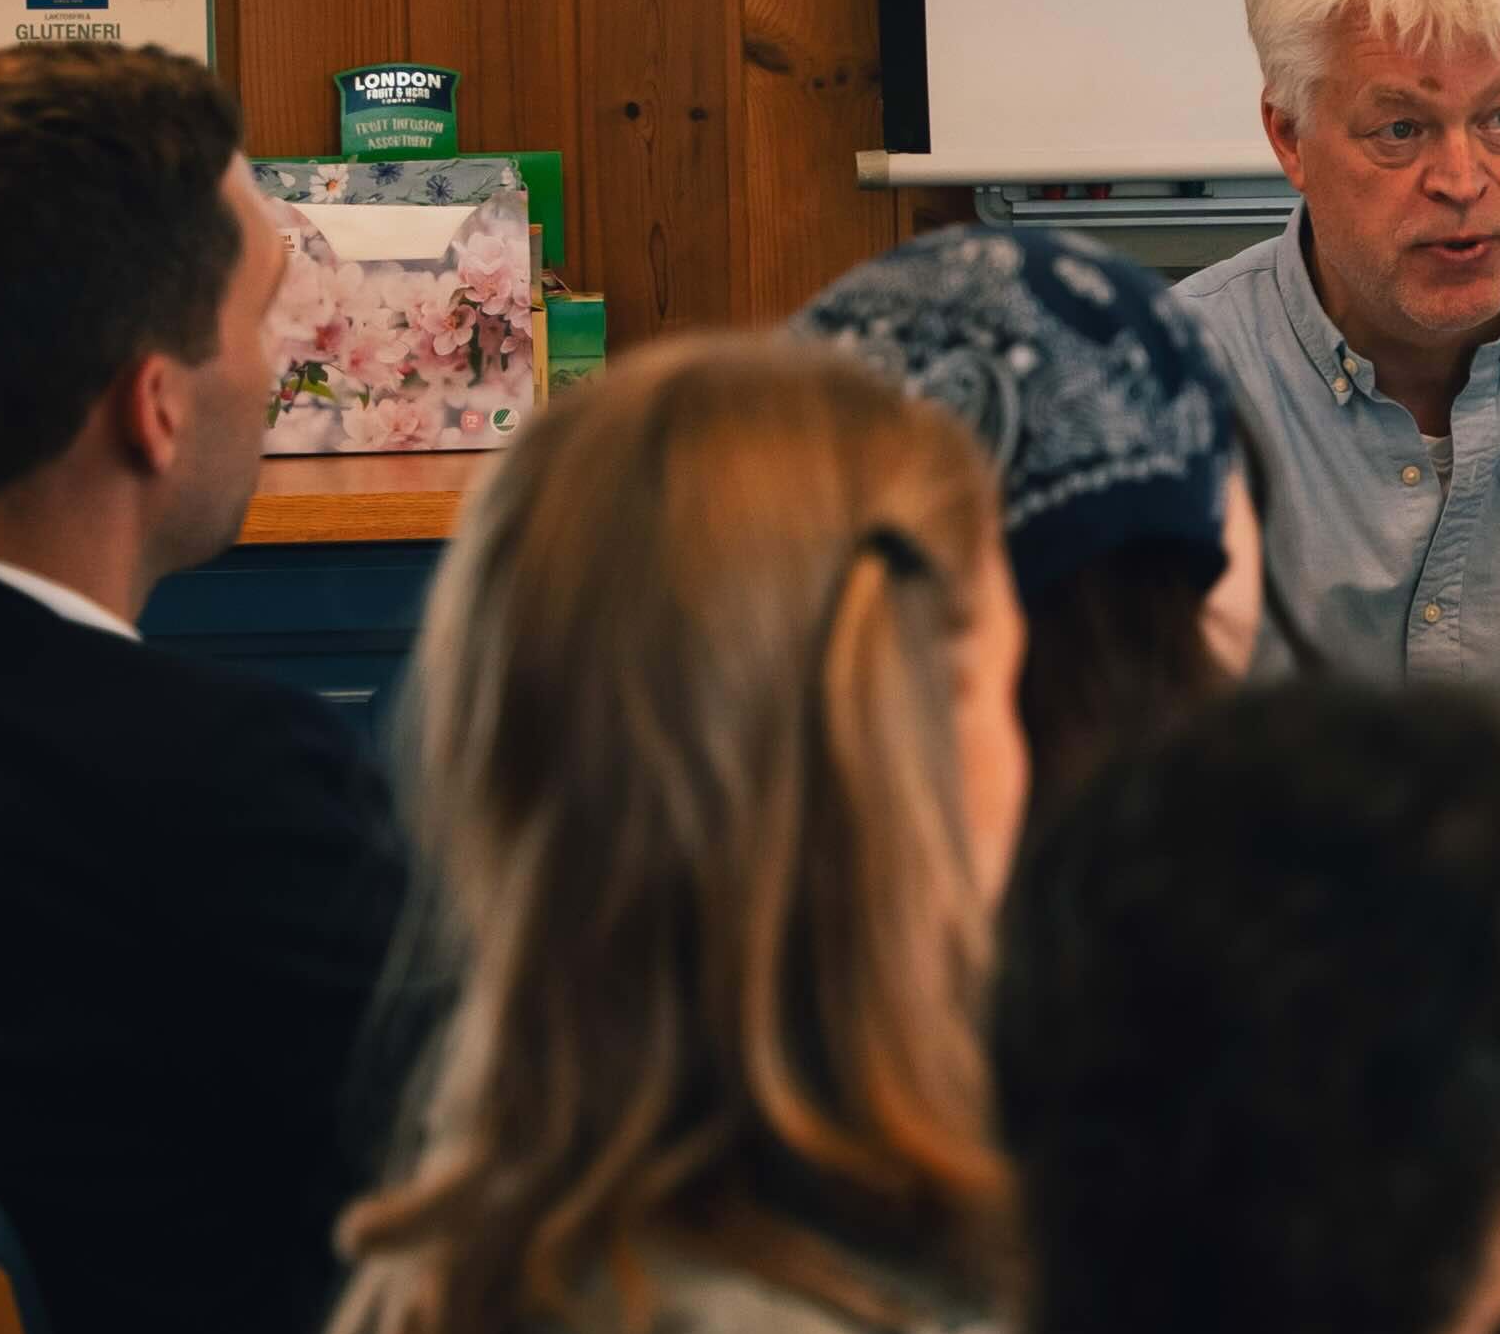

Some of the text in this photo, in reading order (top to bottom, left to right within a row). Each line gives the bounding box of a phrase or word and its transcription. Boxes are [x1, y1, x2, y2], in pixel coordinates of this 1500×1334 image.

[16, 24, 121, 40] GLUTENFRI
[354, 72, 441, 91] LONDON
[366, 88, 393, 100] FRUIT
